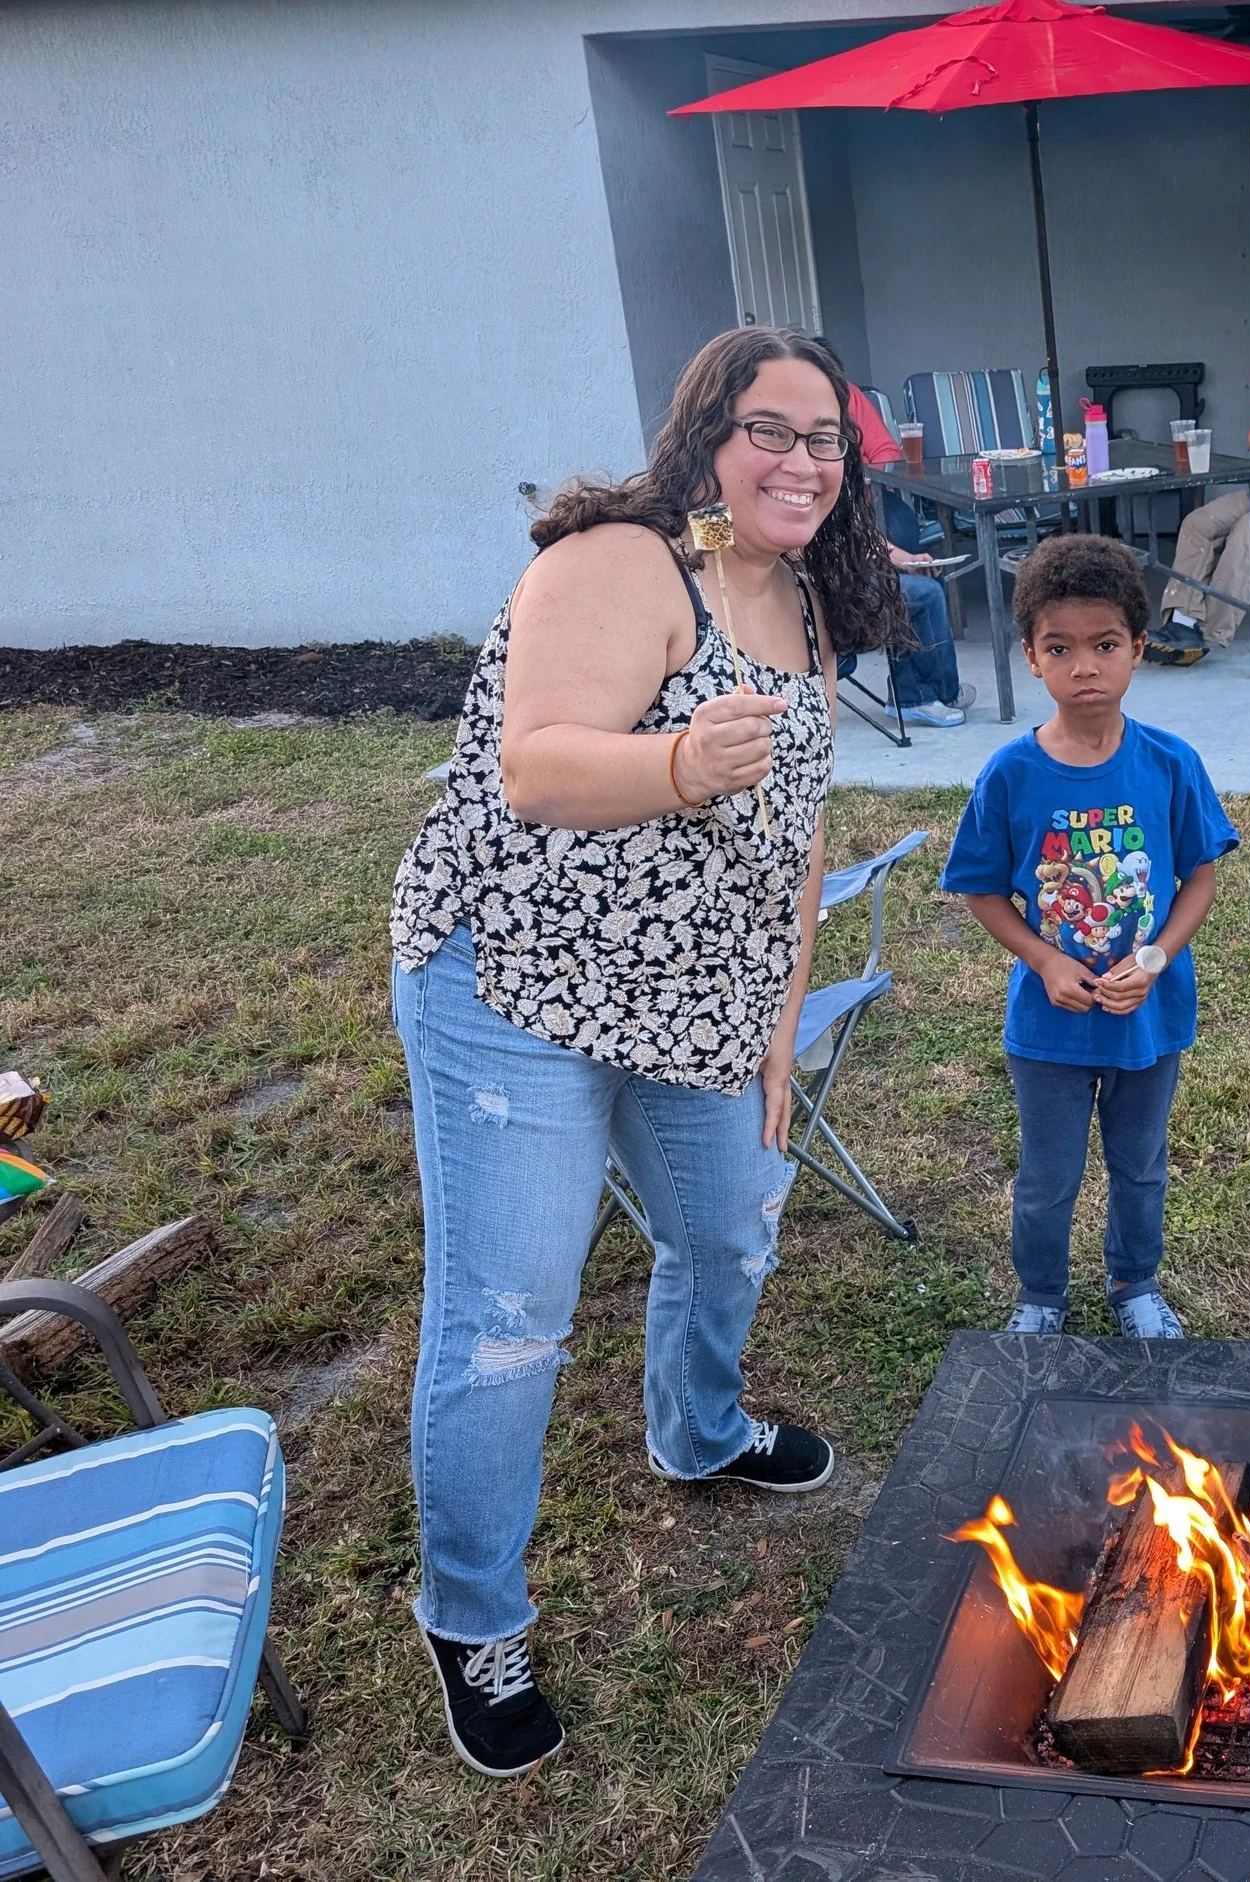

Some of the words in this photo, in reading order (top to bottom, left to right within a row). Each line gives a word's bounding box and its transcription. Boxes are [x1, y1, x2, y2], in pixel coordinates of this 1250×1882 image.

[1068, 454, 1086, 466] FANT
[1052, 805, 1135, 830] SUPER
[1042, 827, 1145, 860] MARIO
